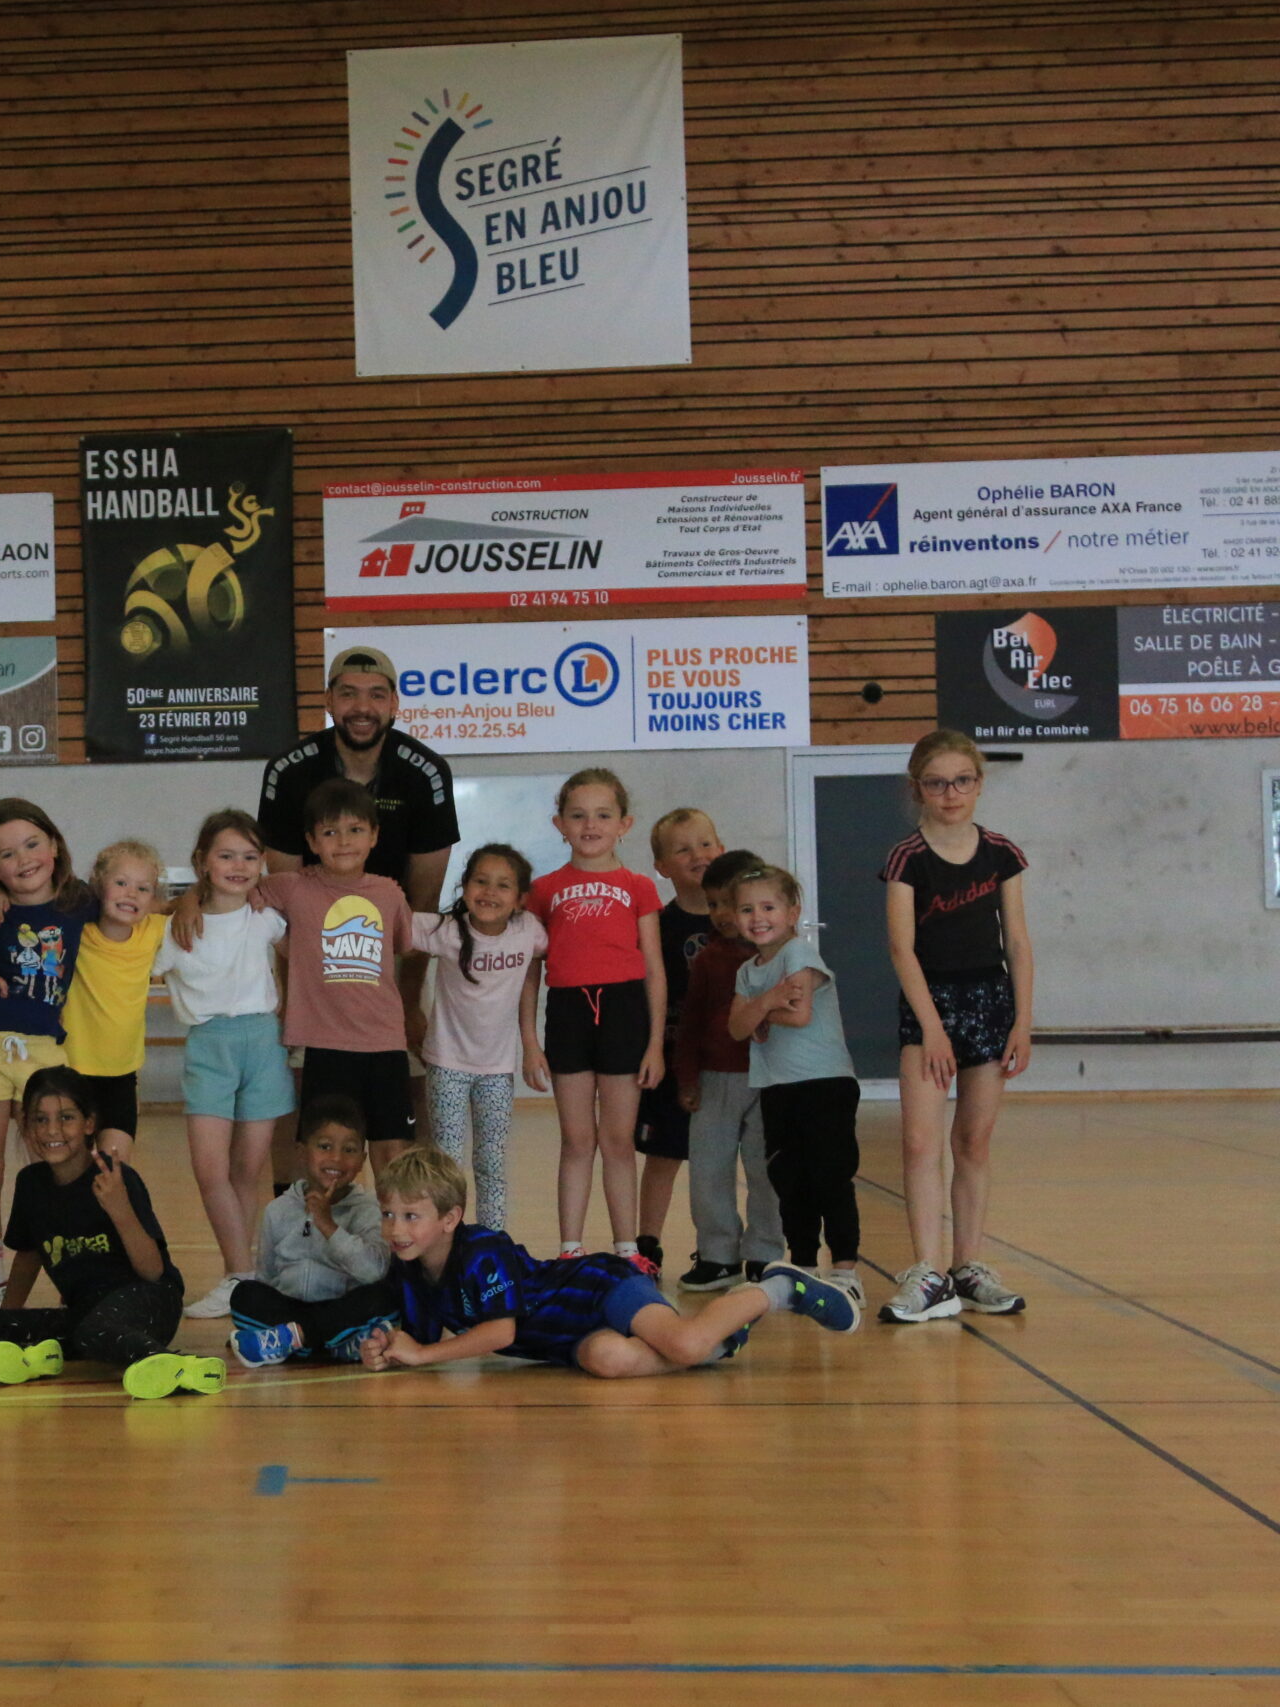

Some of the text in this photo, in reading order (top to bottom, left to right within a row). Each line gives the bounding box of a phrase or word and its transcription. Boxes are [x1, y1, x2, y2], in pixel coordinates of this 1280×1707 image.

[454, 135, 562, 201] SEGRÉ
[484, 180, 647, 247] EN ANJOU
[496, 246, 579, 296] BLEU
[85, 447, 180, 480] ESSHA
[327, 471, 800, 496] contact@jousselin-construction.com Jousselin.fr
[977, 482, 1116, 504] Ophélie BARON
[86, 486, 219, 520] HANDBALL
[667, 503, 772, 514] Maisons Individuelles
[680, 493, 758, 504] Constructeur de
[1229, 496, 1244, 507] 02
[1246, 496, 1260, 506] 41
[490, 508, 589, 523] CONSTRUCTION
[656, 513, 783, 524] Extensions et Rénovations
[913, 500, 1183, 522] Agent général d'assurance AXA France
[679, 525, 701, 534] Tout
[703, 525, 730, 535] Corps
[827, 520, 887, 551] AXA
[1067, 528, 1189, 548] notre métier
[663, 547, 780, 558] Travaux de Gros-Oeuvre
[909, 533, 1040, 553] réinventons
[1230, 547, 1245, 558] 02
[1247, 547, 1261, 557] 41
[414, 539, 603, 575] JOUSSELIN
[645, 556, 797, 569] Bâtiments Collectifs Industriels
[658, 567, 785, 579] Commerciaux et Tertiaires
[832, 580, 874, 593] E-mail
[882, 575, 1038, 593] ophelie.baron.agt@axa.fr
[510, 590, 610, 607] 02 41 94 75 10
[1162, 602, 1265, 625] ÉLECTRICITÉ
[992, 627, 1030, 648] Bel
[1133, 632, 1262, 652] SALLE DE BAIN
[646, 645, 798, 666] PLUS PROCHE
[1010, 649, 1043, 668] Air
[1187, 654, 1262, 677] POÊLE À
[395, 662, 547, 697] eclerc
[647, 669, 741, 688] DE VOUS
[1027, 668, 1073, 689] Elec
[167, 686, 259, 704] ANNIVERSAIRE
[648, 690, 762, 711] TOUJOURS
[1129, 694, 1263, 716] 06 75 16 06 28
[139, 709, 248, 728] 23 FÉVRIER 2019
[395, 701, 555, 722] egré-en-Anjou Bleu
[408, 722, 527, 740] 02.41.92.25.54
[648, 712, 787, 734] MOINS CHER
[975, 721, 1089, 737] Bel Air de Combrée
[550, 881, 632, 912] AIRNESS
[562, 898, 614, 924] Sport
[321, 932, 383, 964] WAVES
[471, 951, 525, 971] didas
